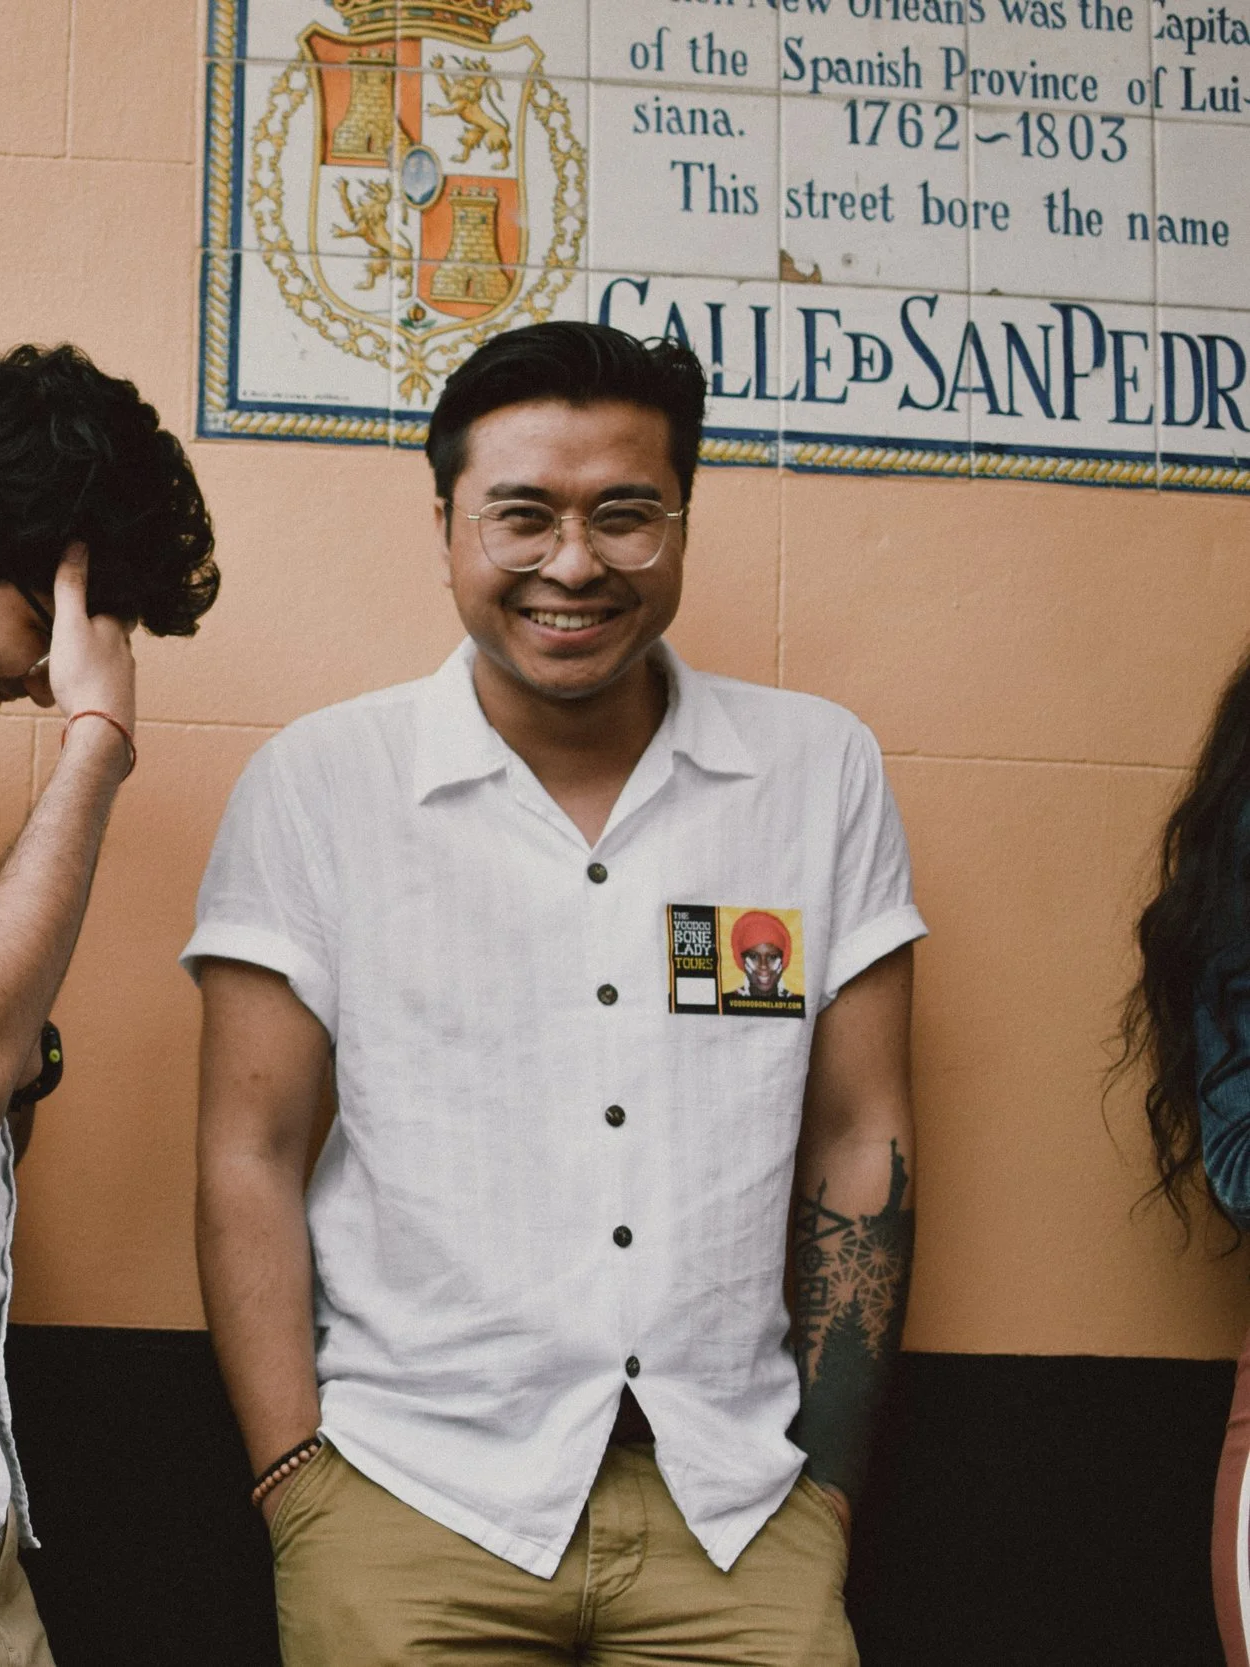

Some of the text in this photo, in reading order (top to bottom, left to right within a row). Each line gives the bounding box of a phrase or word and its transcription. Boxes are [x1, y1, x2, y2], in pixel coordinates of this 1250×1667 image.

[747, 0, 831, 15] ew
[1001, 0, 1067, 29] was
[1080, 0, 1133, 32] the
[630, 26, 671, 72] of
[688, 31, 748, 77] the
[782, 36, 923, 95] Spanish
[939, 46, 1098, 102] Province
[1127, 66, 1167, 109] of
[633, 96, 746, 137] siana.
[670, 160, 1230, 247] This street bore the name
[898, 294, 1056, 420] SAN
[673, 911, 690, 920] THE
[674, 921, 711, 931] VOODOO
[674, 930, 712, 944] BONE
[674, 943, 712, 956] LADY
[675, 957, 714, 970] TOURS
